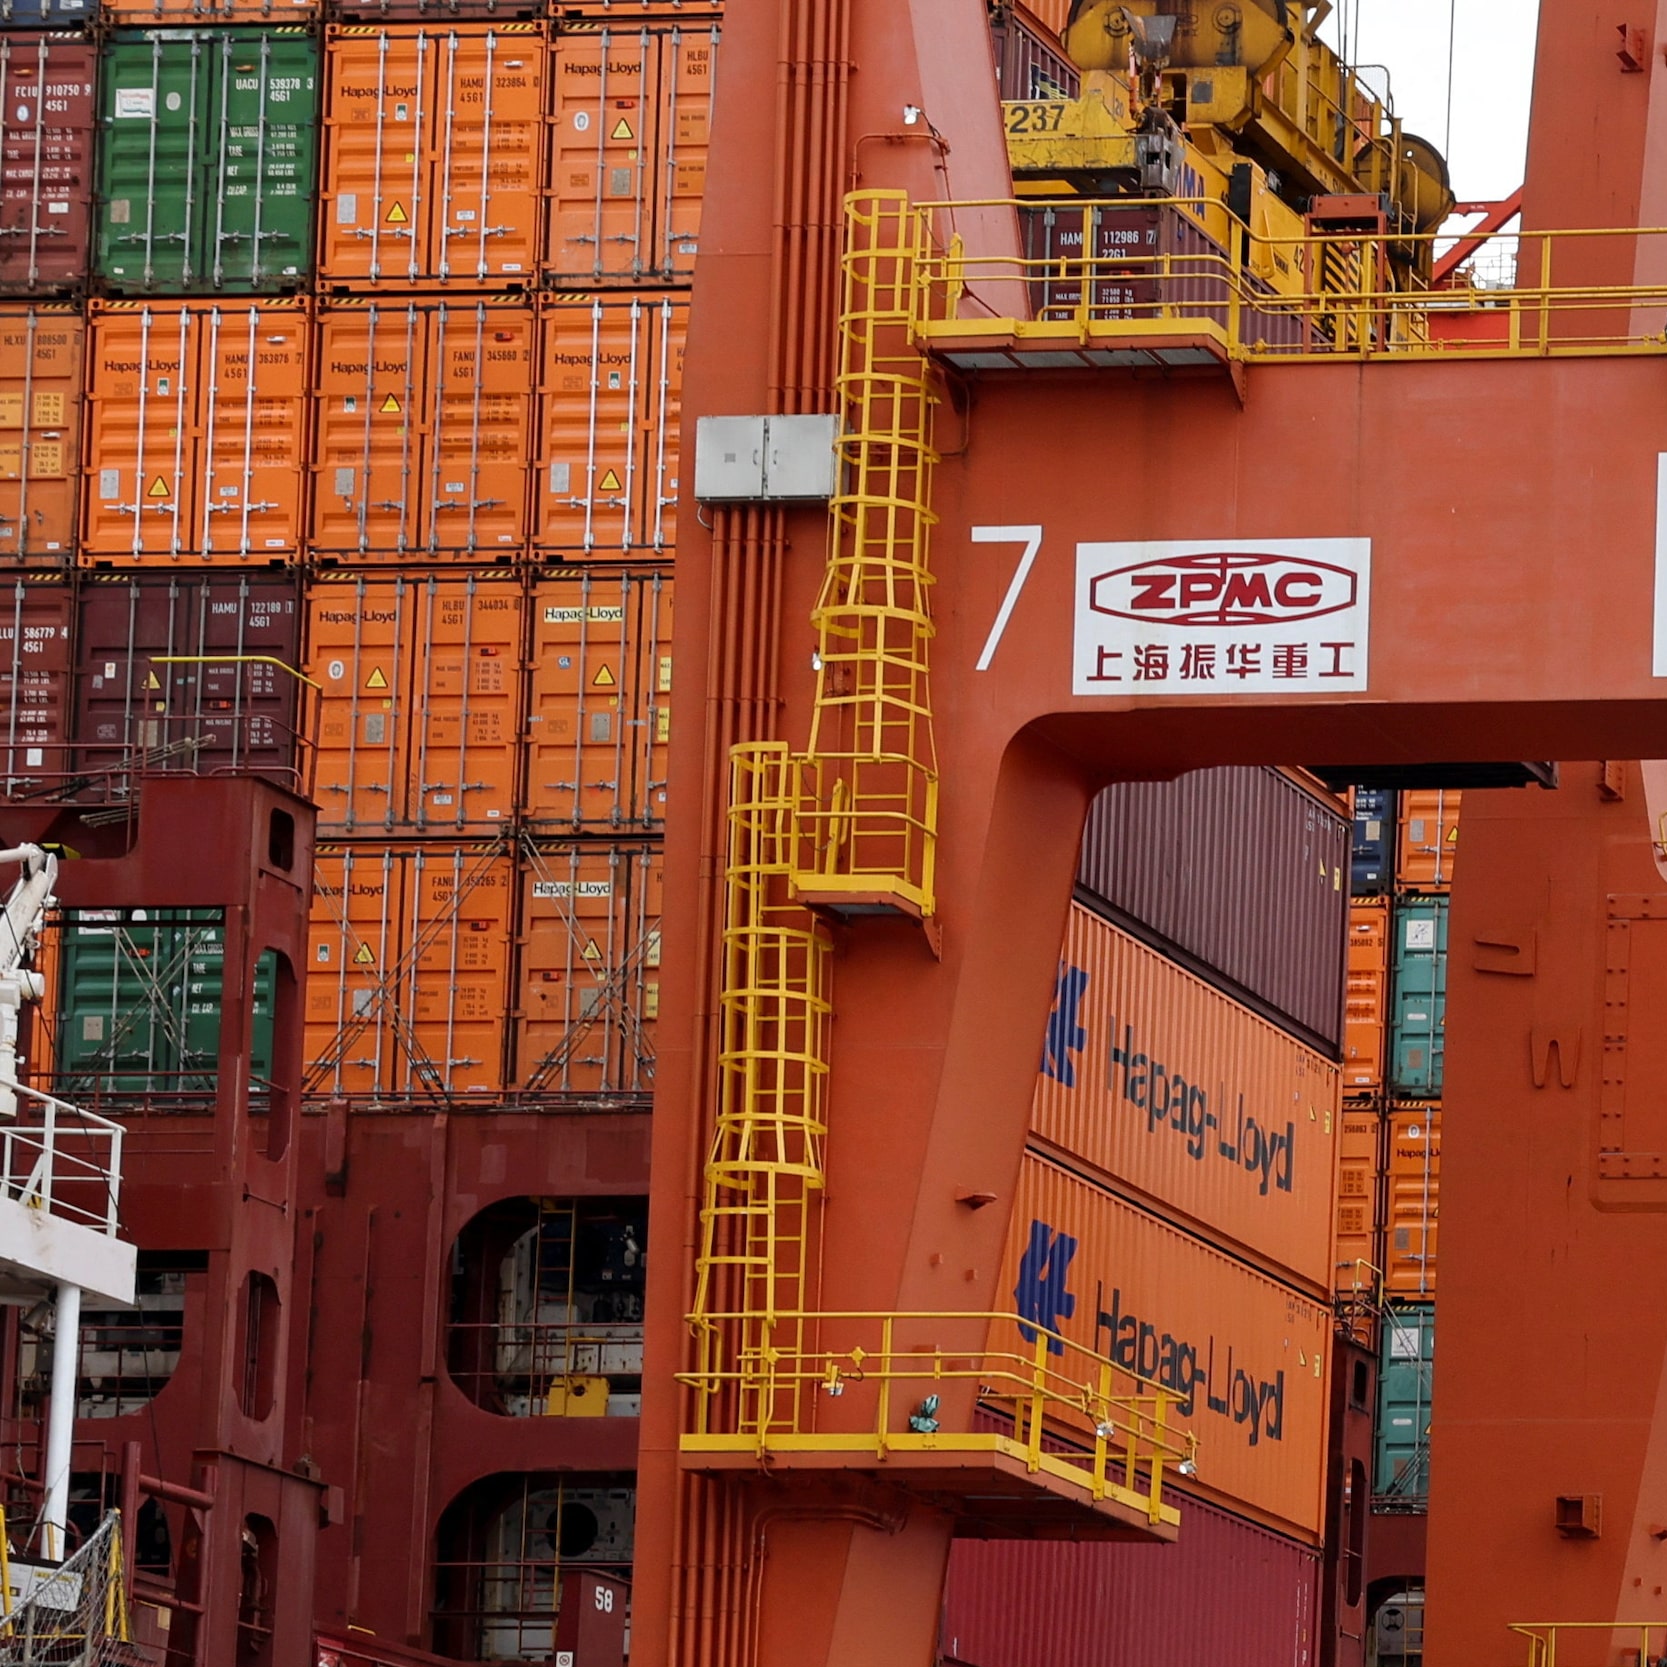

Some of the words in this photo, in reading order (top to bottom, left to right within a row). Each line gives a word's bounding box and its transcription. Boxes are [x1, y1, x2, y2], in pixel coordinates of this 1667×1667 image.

[564, 61, 642, 76] Hapag-Lloyd
[46, 85, 80, 96] 910750
[236, 79, 259, 90] UACU
[270, 79, 300, 90] 539378
[341, 86, 418, 99] Hapag-Lloyd
[1103, 231, 1139, 244] 112986
[104, 360, 182, 374] Hapag-Lloyd
[554, 353, 632, 367] Hapag-Lloyd
[331, 361, 408, 374] Hapag-Lloyd
[971, 525, 1043, 671] 7
[1131, 573, 1323, 611] ZPMC
[212, 603, 237, 614] HAMU
[251, 602, 281, 613] 122189
[545, 607, 623, 621] Hapag-Lloyd
[319, 610, 397, 625] Hapag-Lloyd
[24, 627, 54, 638] 586779
[1086, 642, 1355, 681] 上海振华重工
[534, 882, 611, 896] Hapag-Lloyd
[1107, 1015, 1295, 1196] Hapag-Lloyd
[1095, 1280, 1284, 1446] Hapag-Lloyd
[595, 1586, 613, 1613] 58
